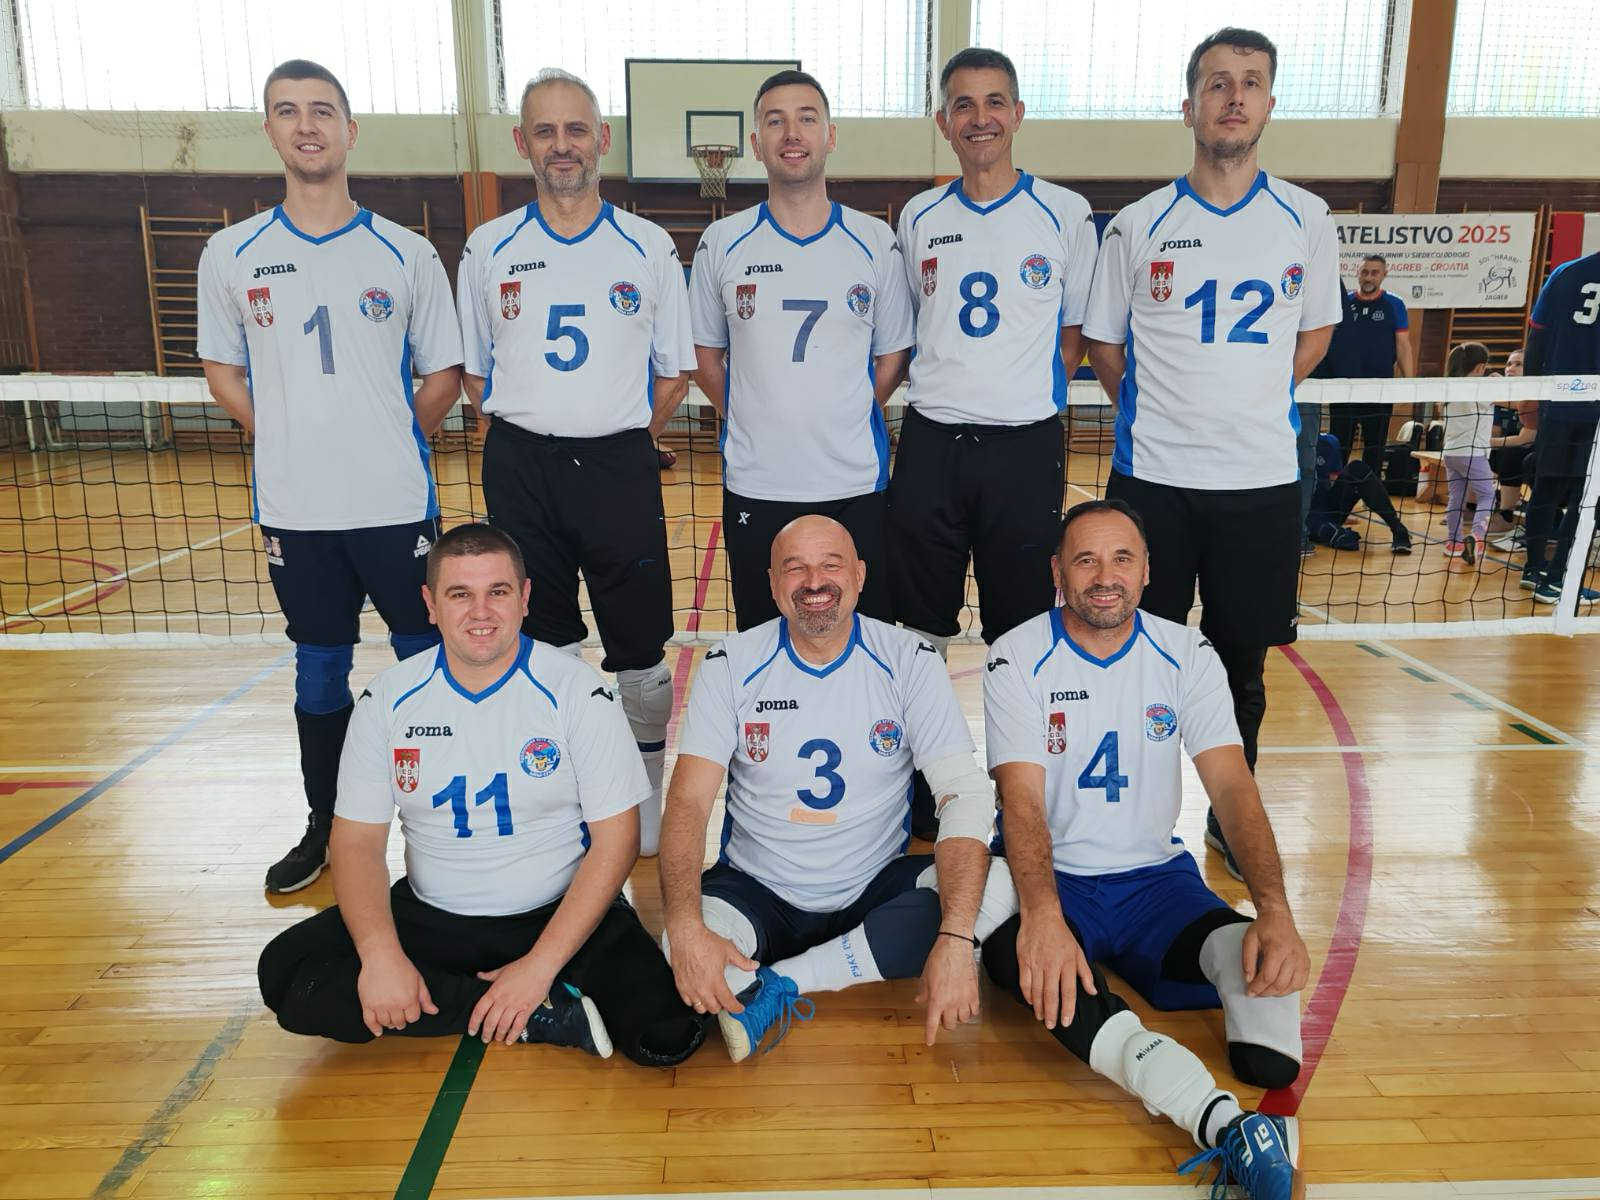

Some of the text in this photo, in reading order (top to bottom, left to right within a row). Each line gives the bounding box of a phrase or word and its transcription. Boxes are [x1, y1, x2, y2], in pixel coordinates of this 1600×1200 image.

[1430, 262, 1470, 272] CROATIA
[1457, 224, 1512, 244] 2025
[782, 299, 829, 363] 7
[958, 271, 1000, 338] 8
[1184, 279, 1275, 344] 12
[1573, 282, 1600, 325] 3
[303, 305, 336, 375] 1
[544, 303, 590, 372] 5
[796, 738, 846, 810] 3
[1077, 730, 1129, 802] 4
[432, 772, 514, 838] 11
